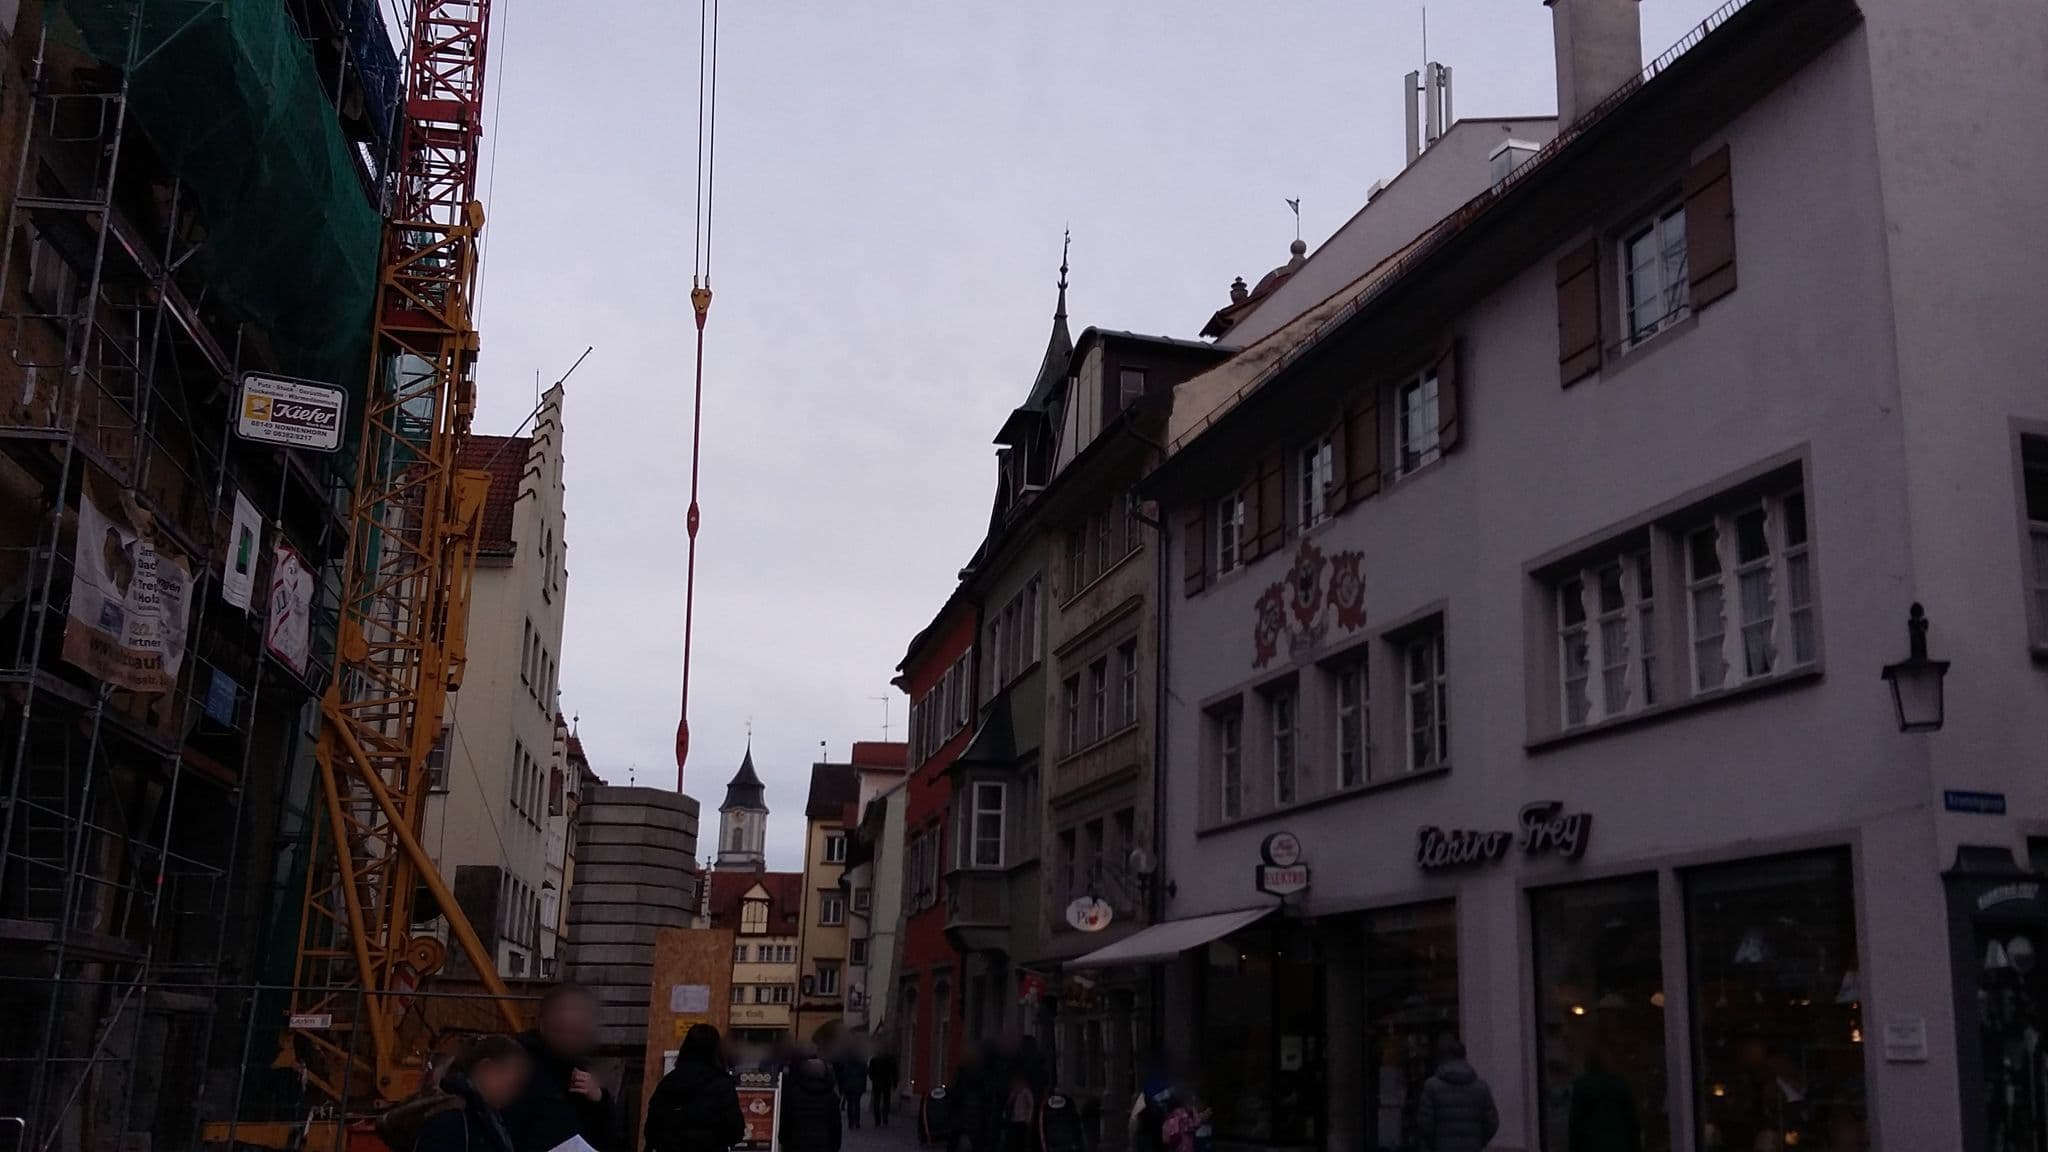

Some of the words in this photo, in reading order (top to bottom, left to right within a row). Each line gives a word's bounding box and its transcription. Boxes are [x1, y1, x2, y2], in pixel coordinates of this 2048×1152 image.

[272, 403, 336, 424] Kiefer
[274, 424, 328, 437] NONNENHORN
[1519, 801, 1592, 858] Frey
